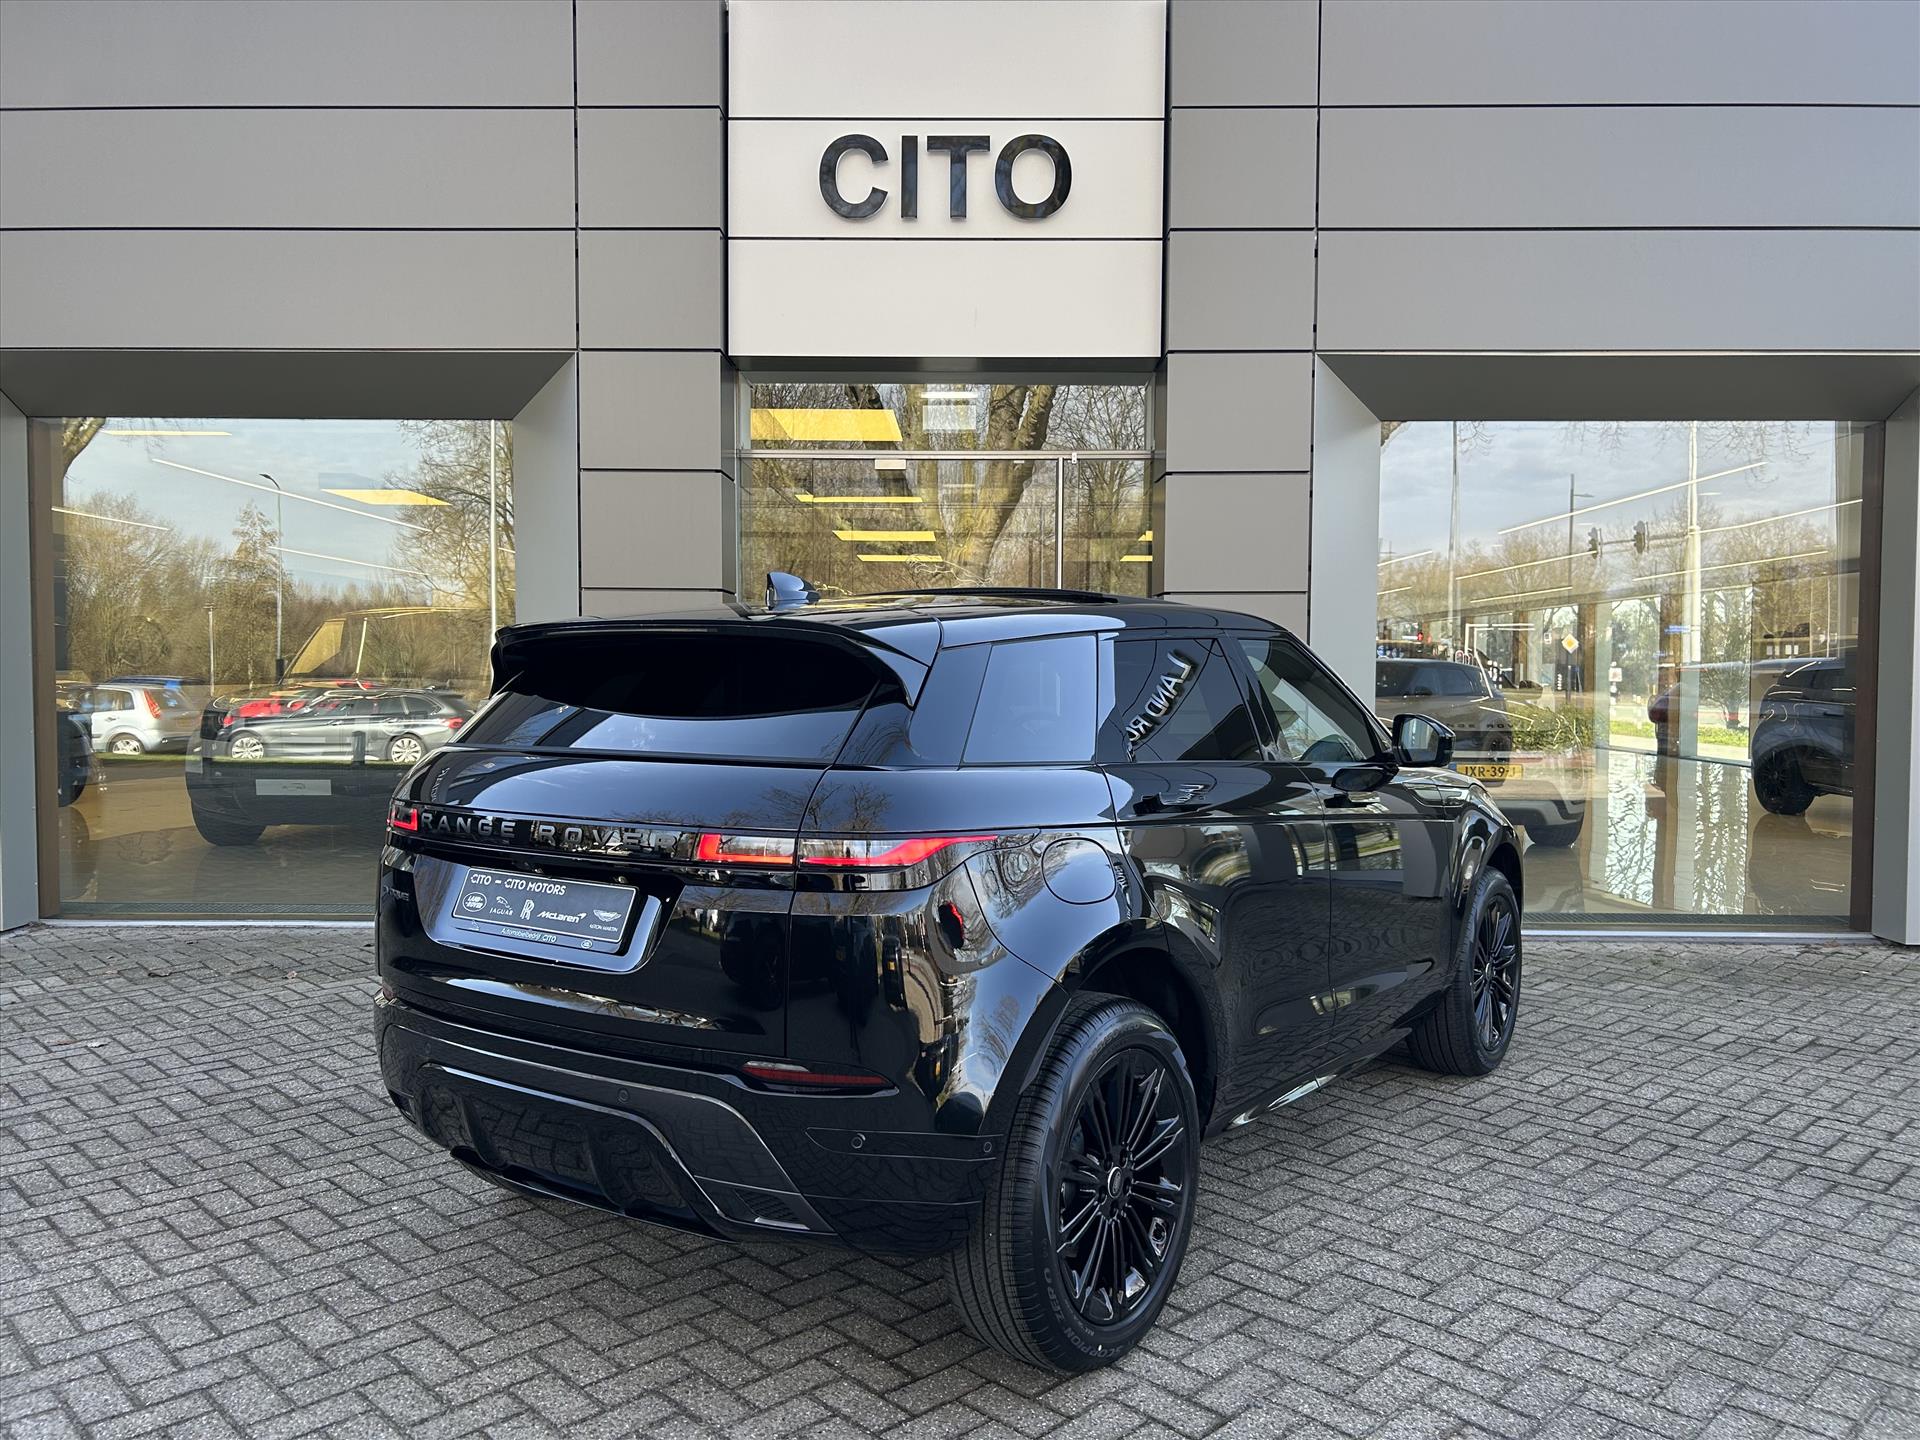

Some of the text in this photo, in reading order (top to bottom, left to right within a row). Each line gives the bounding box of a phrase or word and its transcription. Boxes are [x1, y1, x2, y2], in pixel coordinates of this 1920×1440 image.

[819, 134, 1072, 219] CITO
[421, 812, 678, 850] RANGE ROVER
[471, 874, 491, 885] CITO
[504, 879, 526, 890] CITO
[527, 881, 567, 896] MOTORS
[489, 907, 513, 916] JAGUAR
